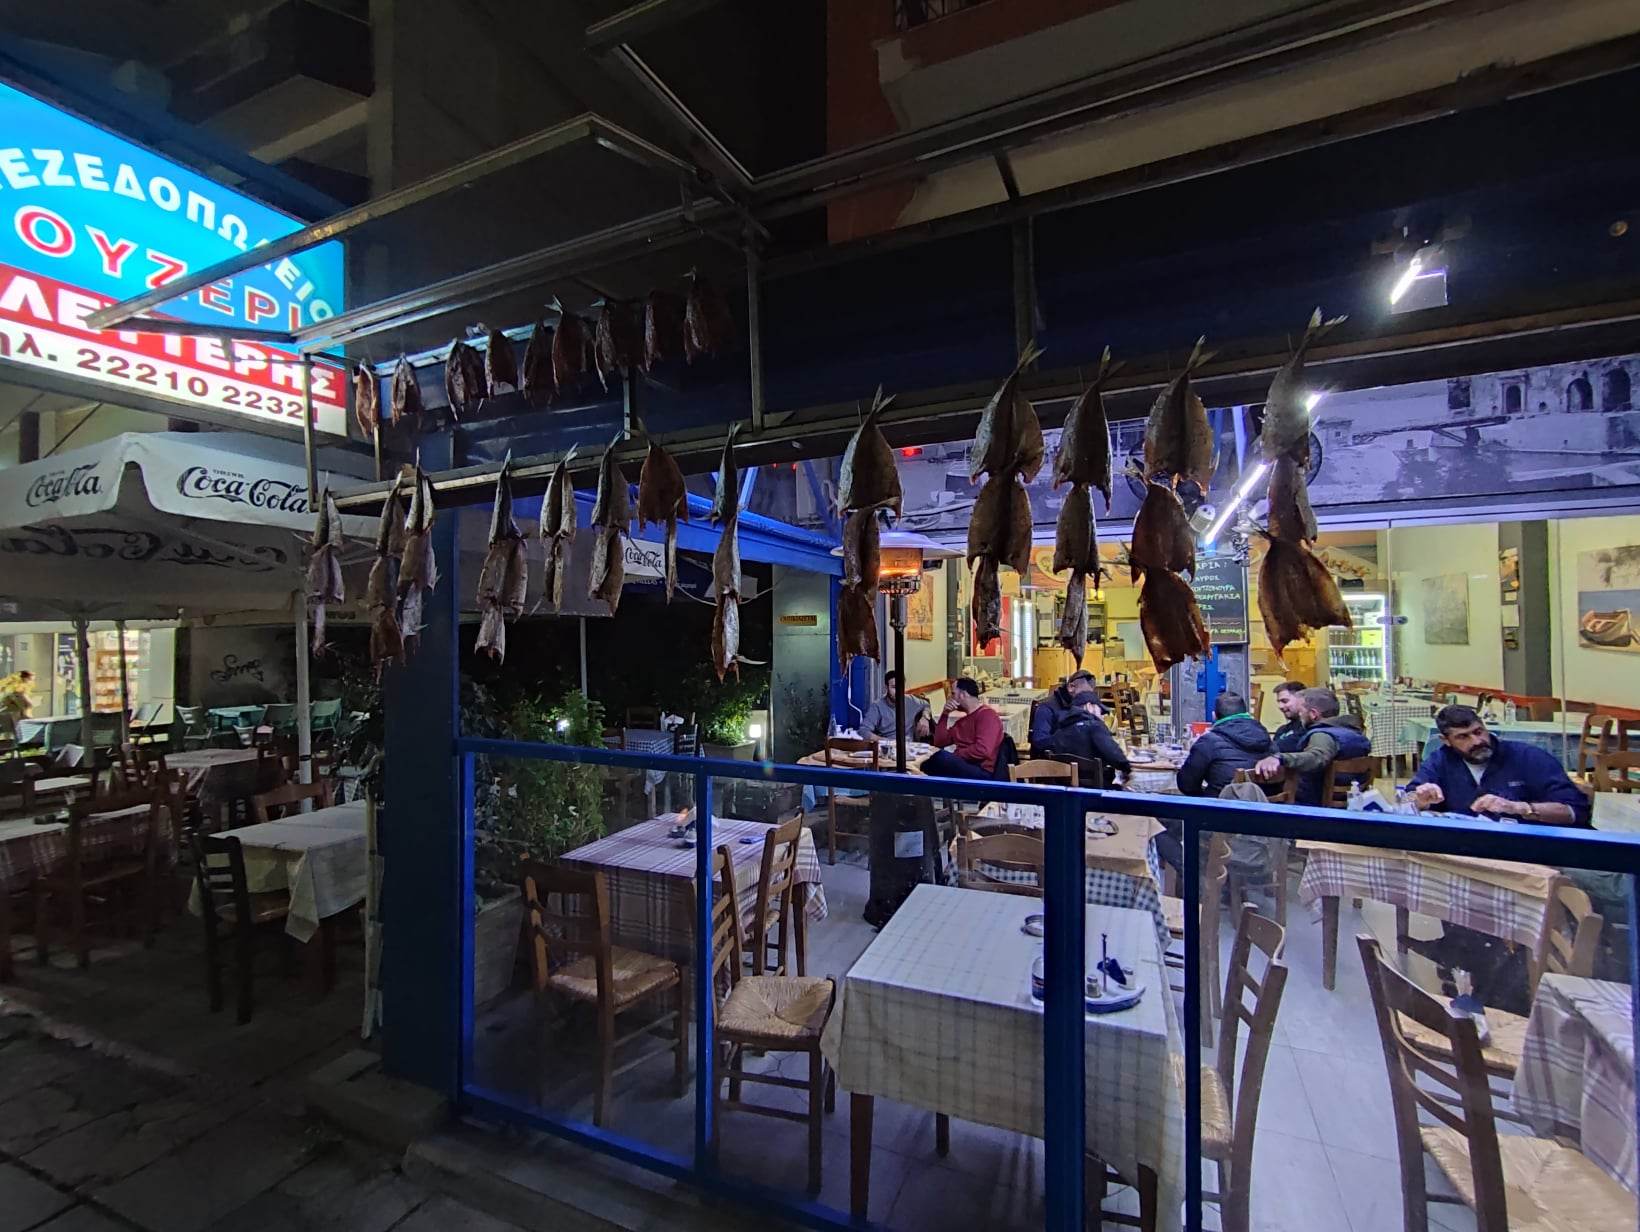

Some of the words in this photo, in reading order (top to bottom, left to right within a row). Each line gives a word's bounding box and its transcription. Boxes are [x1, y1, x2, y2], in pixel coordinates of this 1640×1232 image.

[0, 147, 334, 323] ΕΖΕΔΟΠΩΕΙΟ
[77, 348, 209, 397] 22210
[26, 461, 101, 507] Coca-Cla
[177, 466, 309, 513] Coca-Cola
